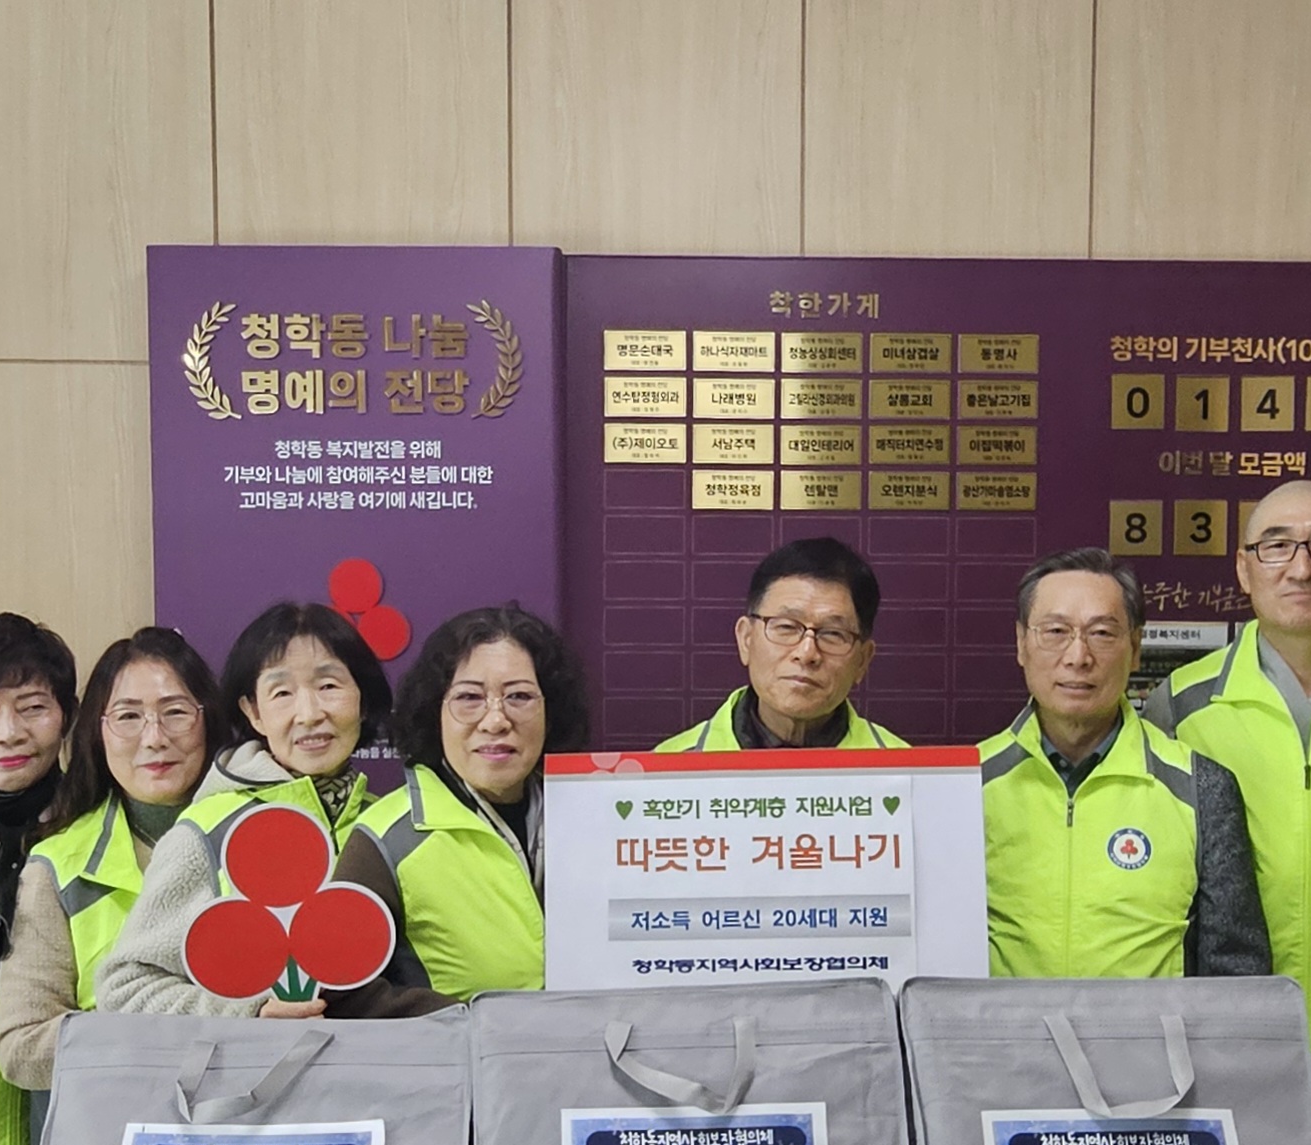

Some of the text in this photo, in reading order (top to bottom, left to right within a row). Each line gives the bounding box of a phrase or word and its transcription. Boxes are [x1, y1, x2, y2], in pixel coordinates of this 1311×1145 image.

[769, 290, 880, 319] 착한가게
[240, 313, 470, 360] 청학동 나눔
[1110, 336, 1178, 362] 청학의
[241, 369, 470, 415] 명예의 전당
[274, 440, 442, 460] 청학동 복지발전을 위해
[224, 465, 494, 485] 기부와 나눔에 참여해주신 분들에 대한
[1159, 451, 1308, 477] 이번 달 모금액
[239, 491, 479, 510] 고마움과 사랑을 여기에 새깁니다.
[1124, 512, 1148, 544] 8
[1190, 512, 1213, 544] 3
[643, 796, 872, 819] 혹한기 취약계층 지원사업
[616, 832, 902, 873] 따뜻한 겨울나기
[631, 907, 889, 930] 저소득 어르신 20세대 지원
[632, 956, 889, 974] 청학동지역사회보장협의체
